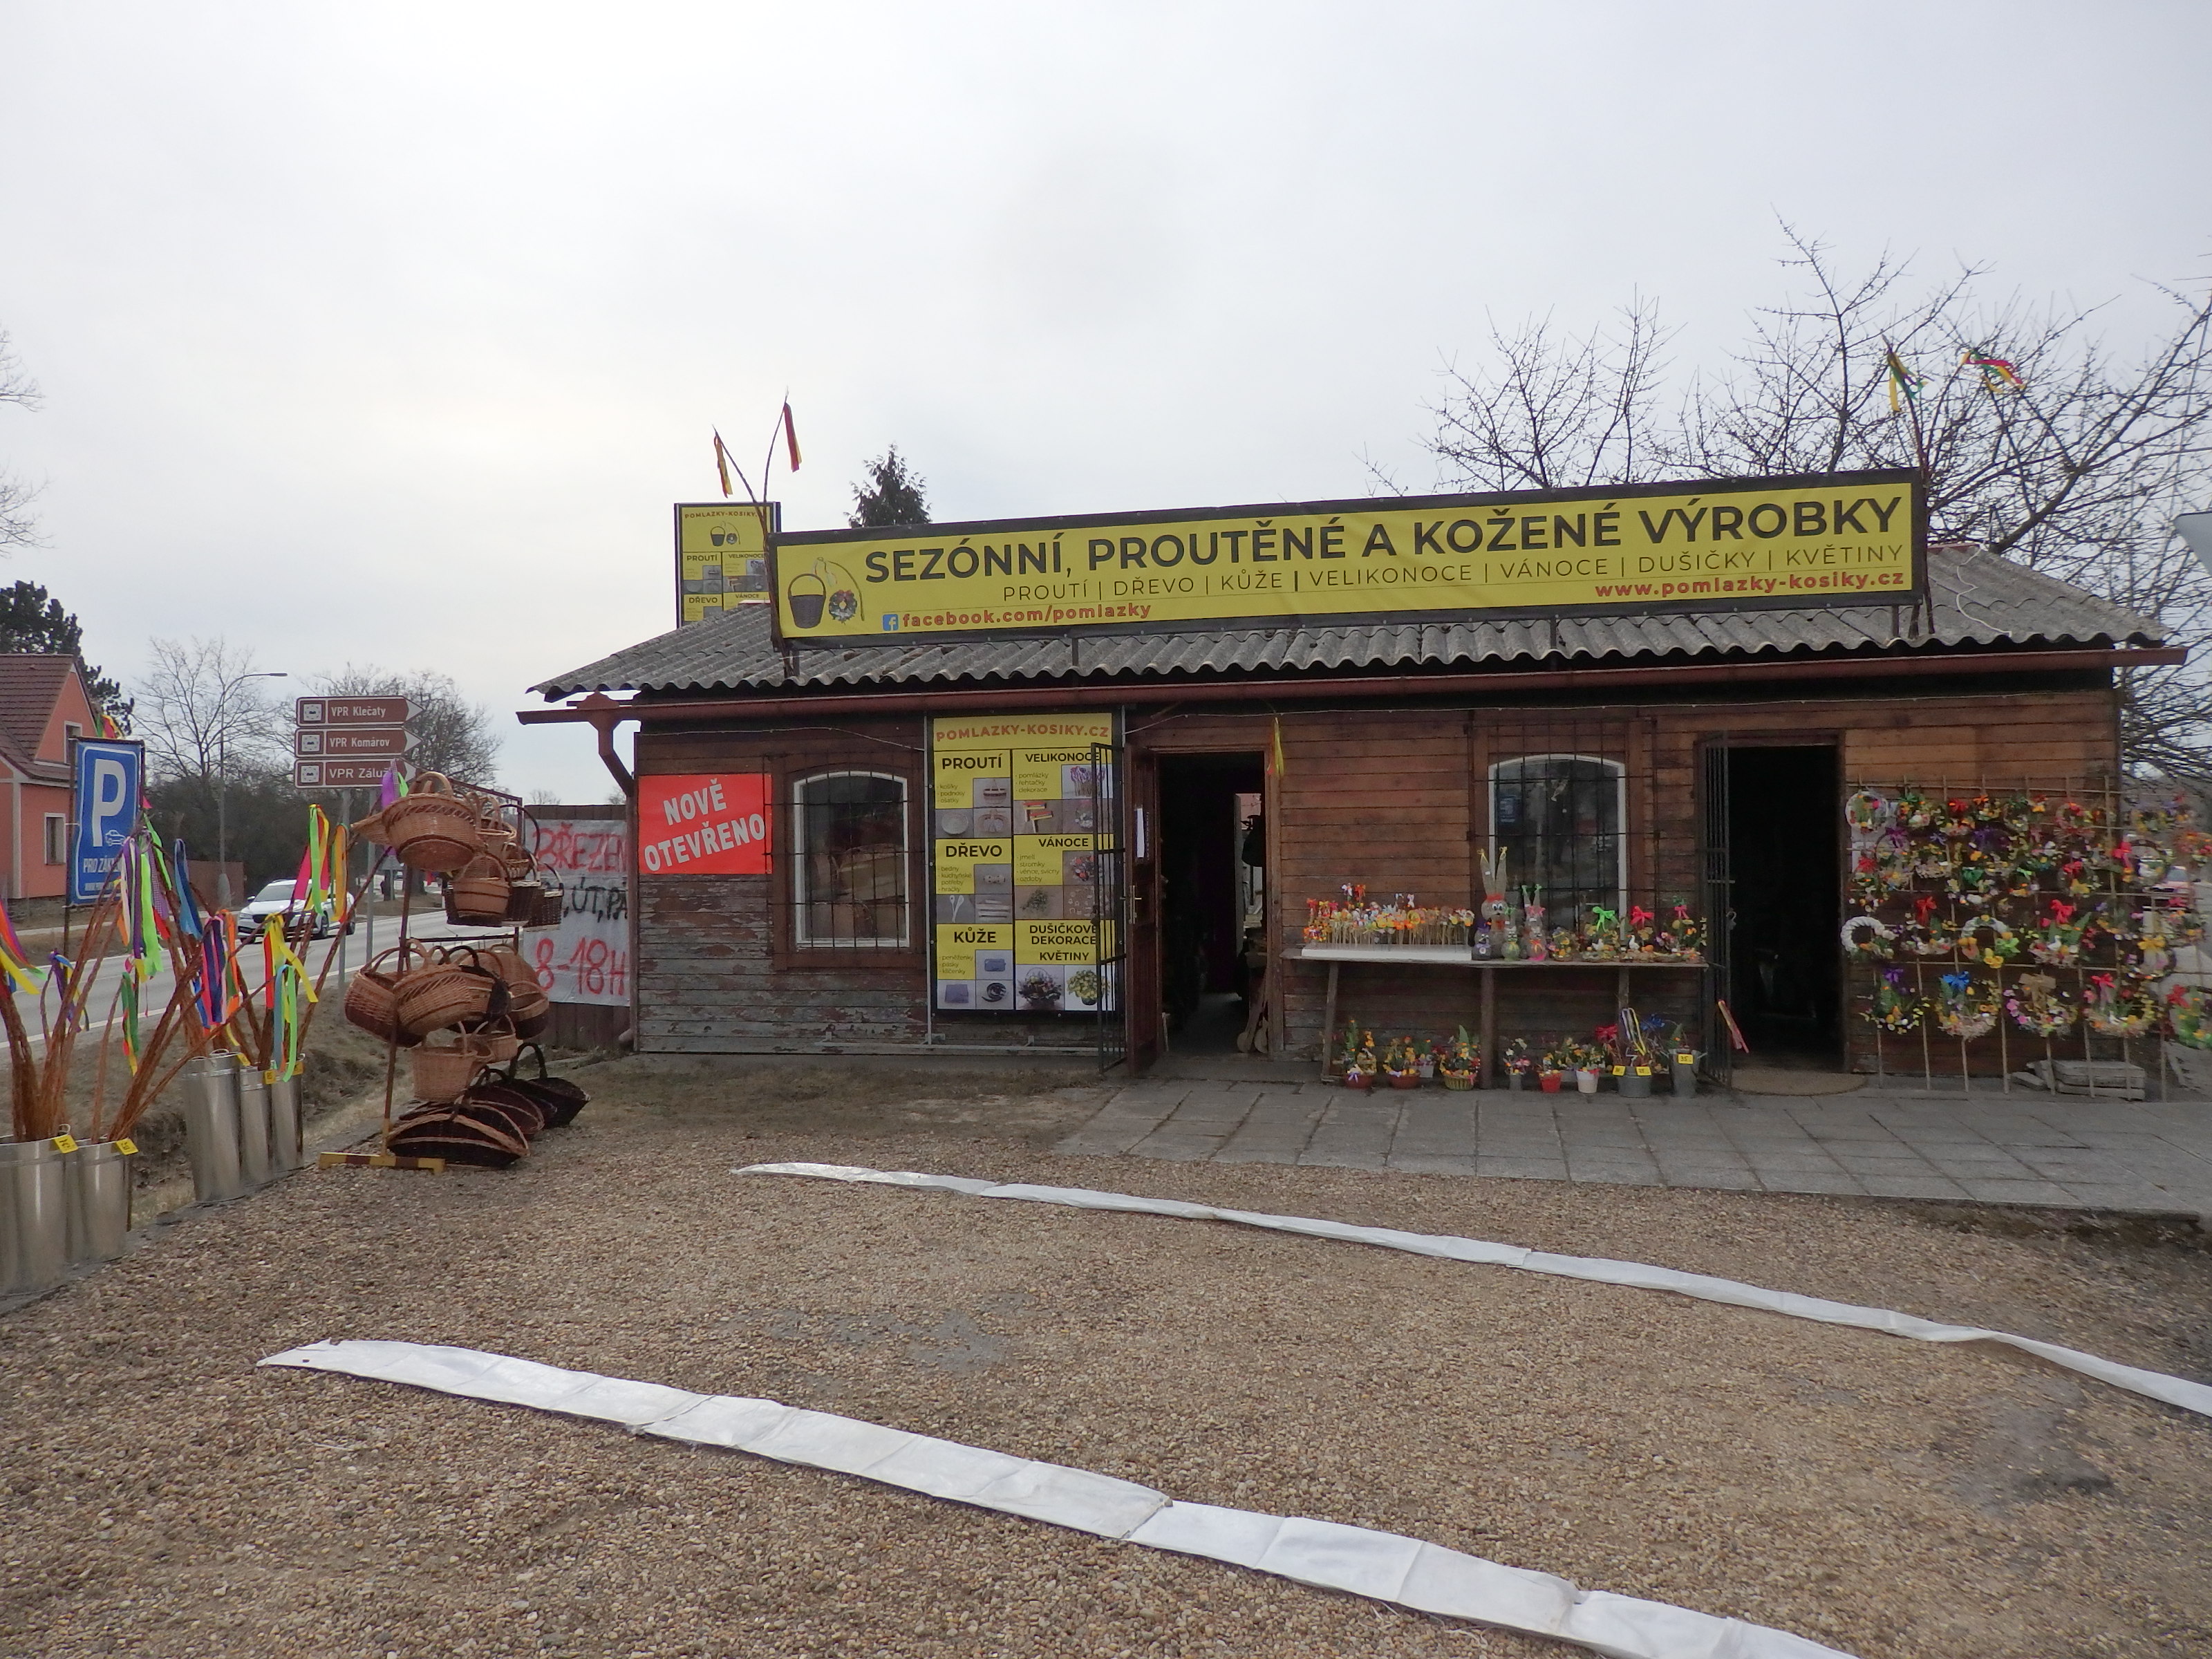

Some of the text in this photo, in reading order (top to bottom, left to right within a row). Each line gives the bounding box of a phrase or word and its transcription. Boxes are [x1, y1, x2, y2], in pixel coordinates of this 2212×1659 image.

[865, 497, 1902, 585] SEZÓNNÍ, PROUTĚNÉ A KOŽENÉ VÝROBKY
[1004, 541, 1903, 603] PROUTÍ DŘEVO KŮŽE VELIKONOCE VÁNOCE DUŠIČKY KVĚTINY
[1595, 572, 1904, 599] www.pomlazky-kosiky.cz
[903, 603, 1152, 628] facebook.com/pomlazky
[331, 706, 386, 718] VPR Klečaty
[936, 724, 1109, 742] POMLAZKY-KOSIKY.CZ
[330, 737, 390, 747] VPR Komárov
[942, 753, 1002, 770] PROUTÍ
[1025, 752, 1100, 762] VELIKONOCE
[329, 768, 354, 778] VPR
[92, 759, 126, 847] P
[664, 778, 727, 825] NOVĚ
[644, 814, 765, 872] OTEVŘENO
[946, 843, 1002, 857] DŘEVO
[1039, 837, 1089, 847] VÁNOCE
[954, 926, 997, 943] KŮŽE
[1031, 935, 1096, 945] DEKORACE
[1040, 950, 1089, 961] KVĚTINY
